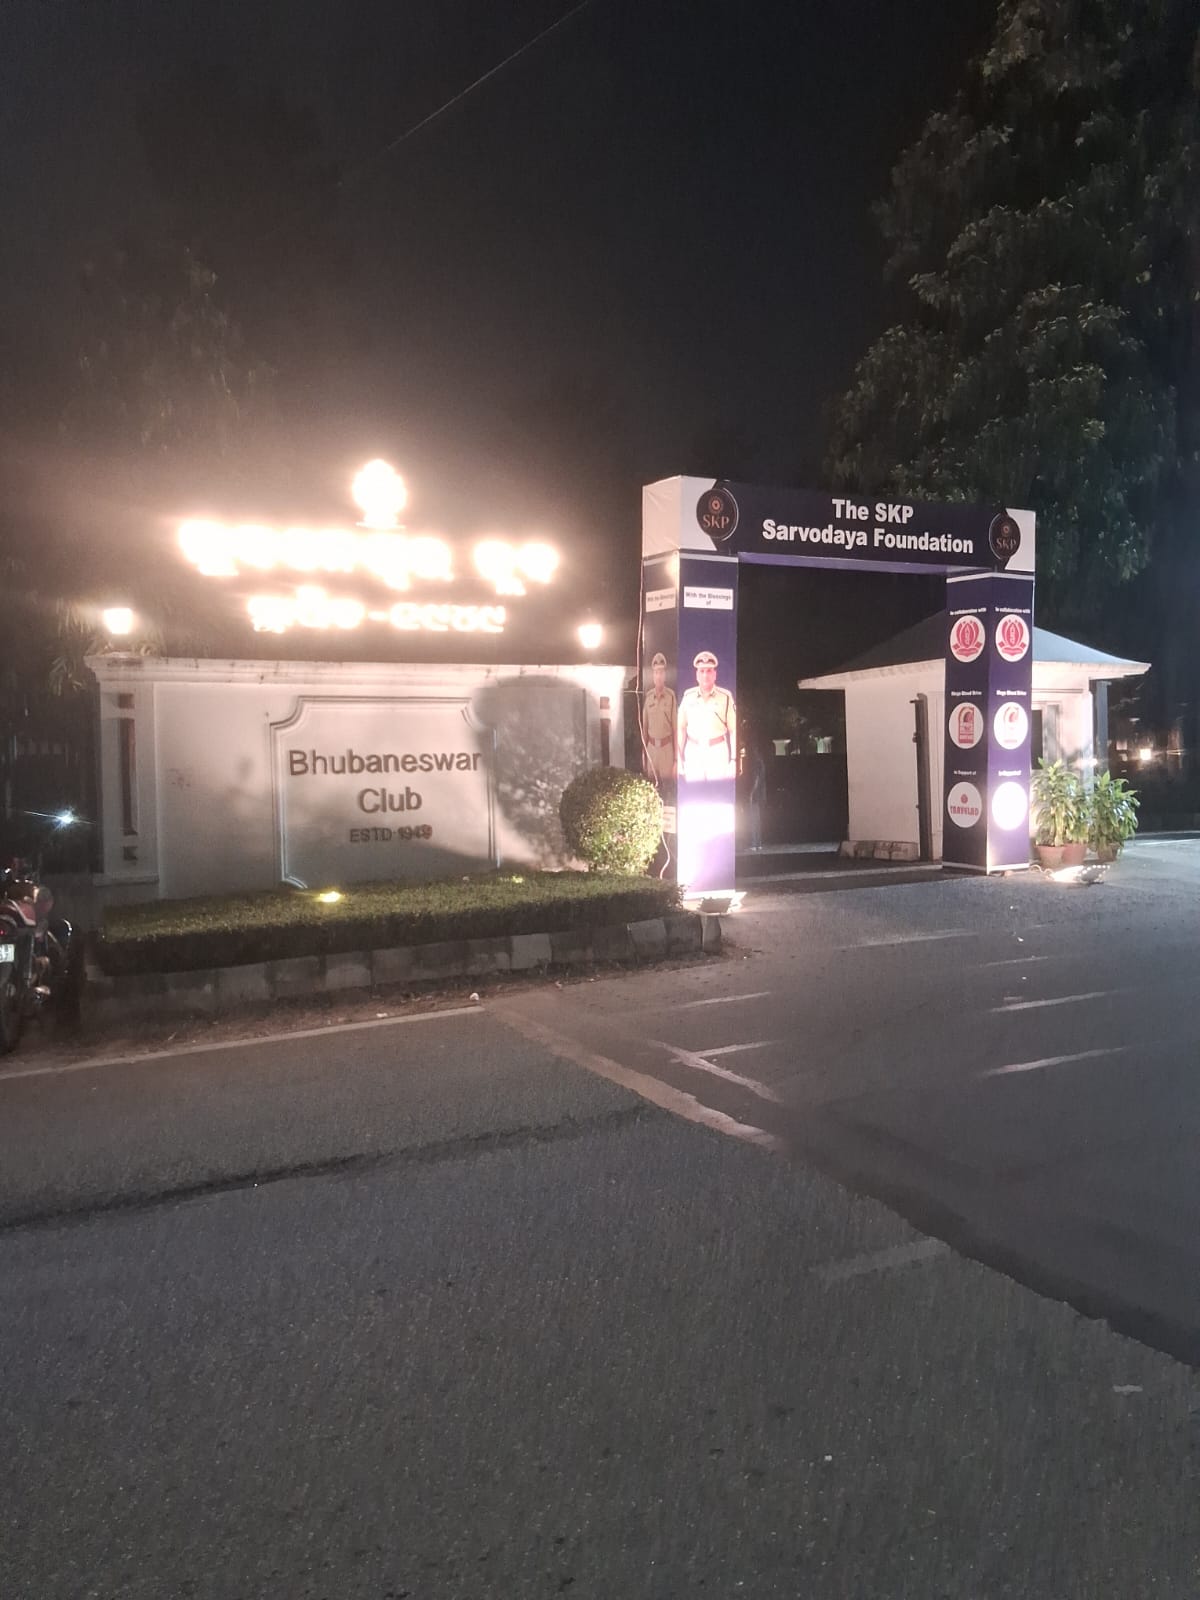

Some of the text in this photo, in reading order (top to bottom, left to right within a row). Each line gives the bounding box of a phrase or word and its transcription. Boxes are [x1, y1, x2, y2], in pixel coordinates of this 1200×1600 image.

[703, 514, 729, 528] SKP
[832, 499, 913, 524] The SKP
[762, 519, 973, 554] Sarvodaya Foundation
[995, 537, 1017, 549] SKP
[289, 748, 482, 776] Bhubaneswar
[357, 787, 422, 813] Club
